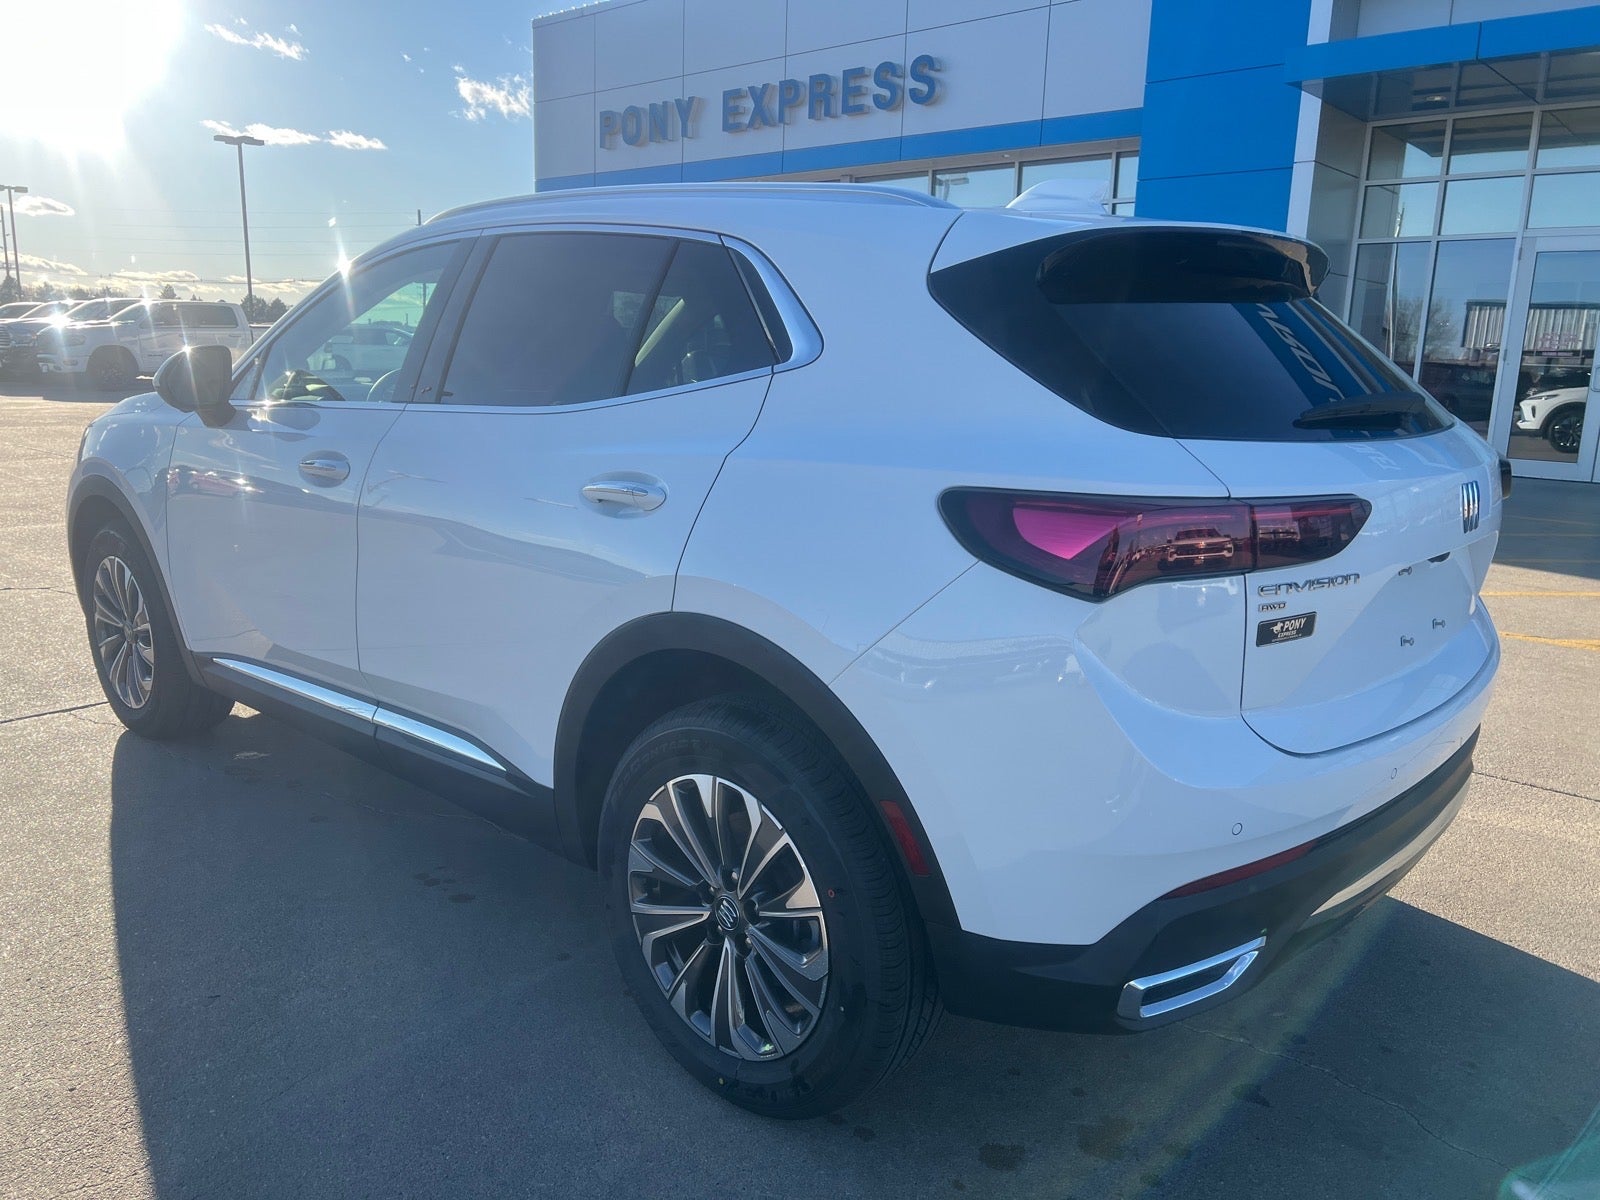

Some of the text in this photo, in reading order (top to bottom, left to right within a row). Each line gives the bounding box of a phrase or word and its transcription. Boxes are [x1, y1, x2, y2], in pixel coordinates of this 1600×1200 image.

[599, 54, 942, 149] PONY EXPRESS
[1258, 573, 1361, 597] ENVISION
[1260, 601, 1287, 612] AWD
[1283, 617, 1307, 632] PONY
